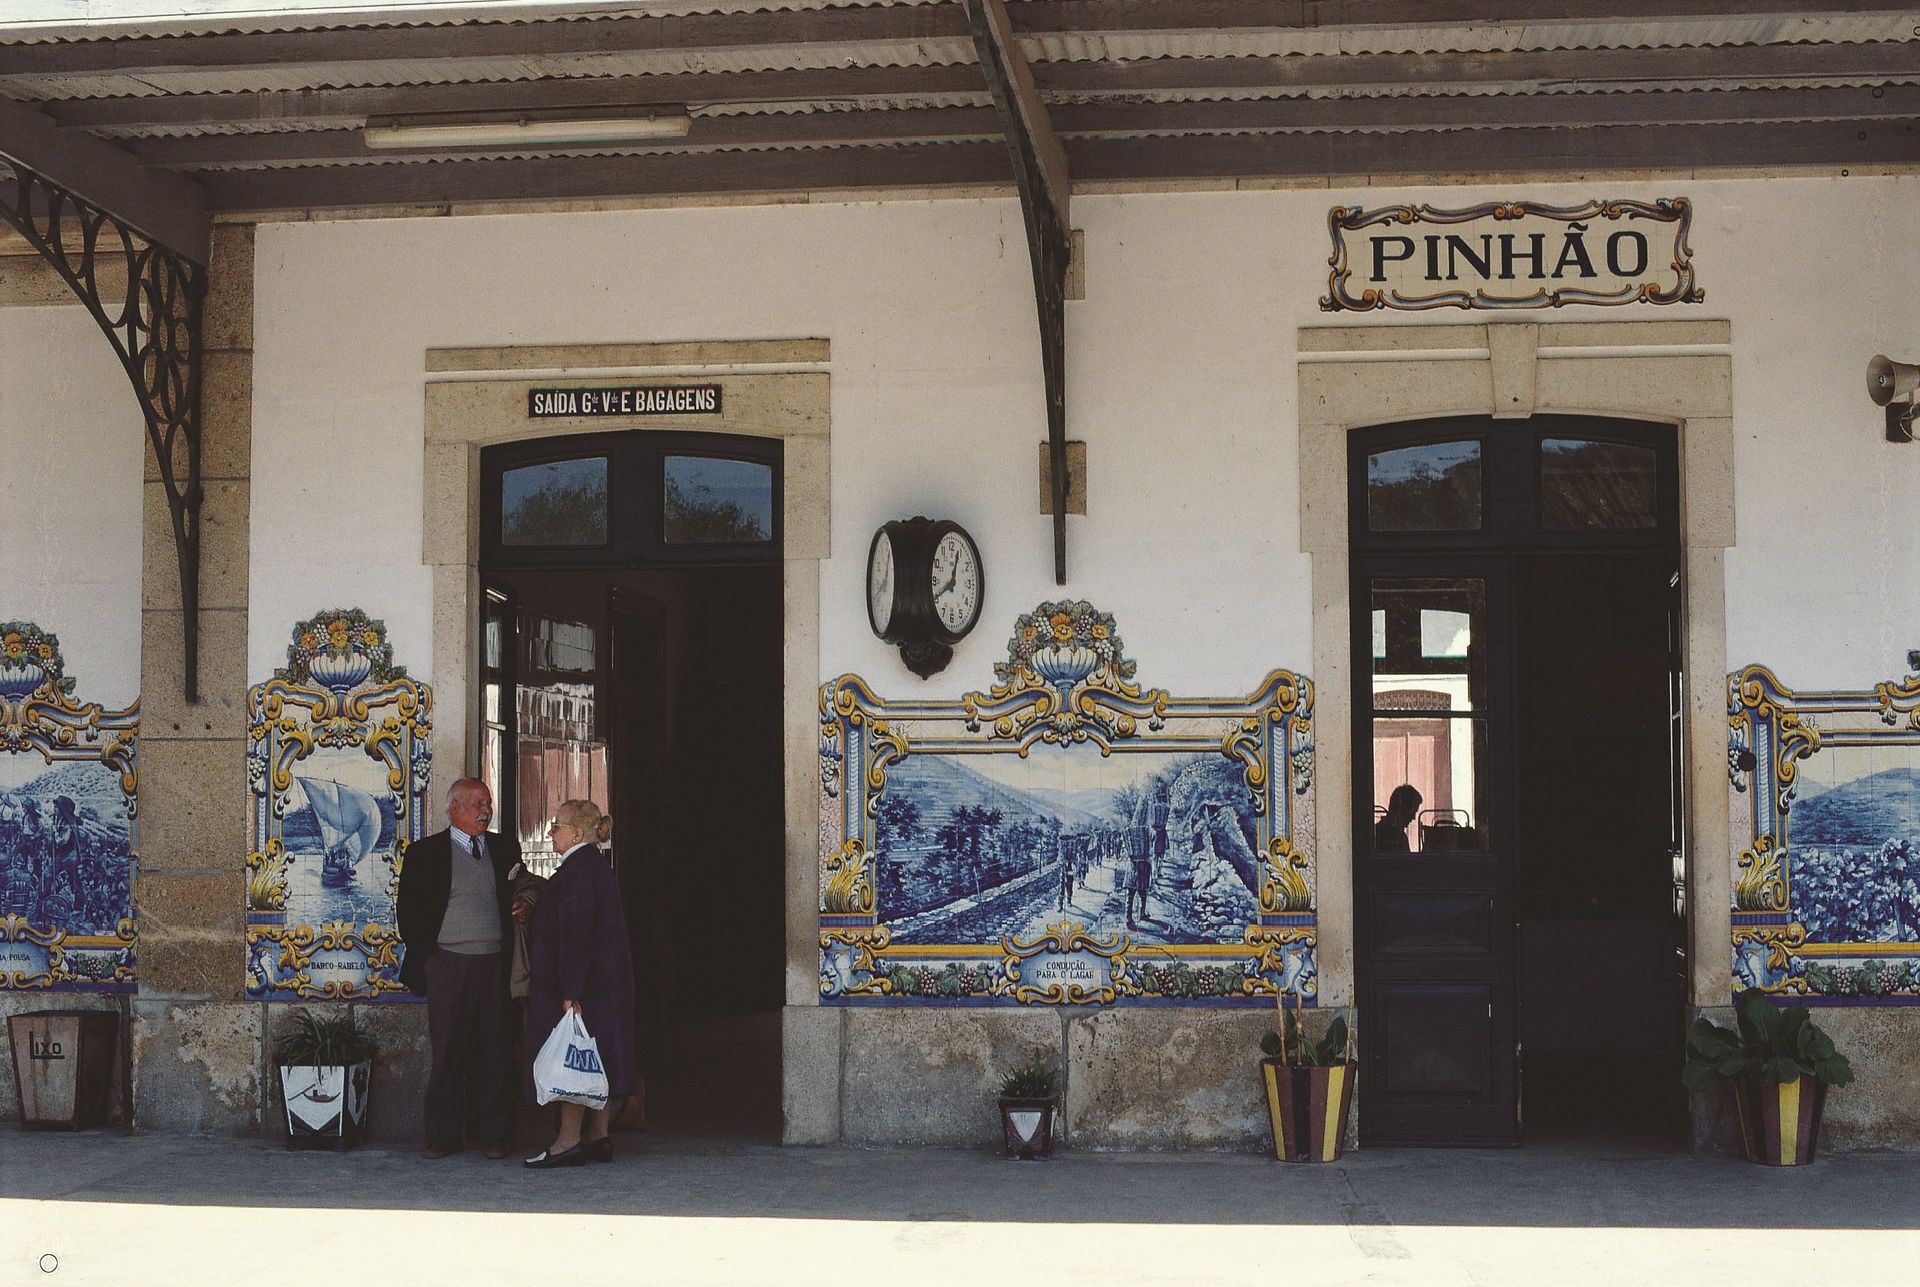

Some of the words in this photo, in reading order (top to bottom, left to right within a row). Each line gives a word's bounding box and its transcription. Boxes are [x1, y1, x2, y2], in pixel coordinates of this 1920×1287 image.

[1369, 222, 1649, 282] PINHÃO
[535, 390, 577, 414] SAÍDA
[621, 391, 631, 412] E
[635, 388, 716, 412] BAGAGENS
[964, 562, 970, 572] 2
[966, 579, 972, 589] 3
[949, 613, 955, 623] 6
[1046, 960, 1086, 972] CONDUÇÃO
[1036, 970, 1057, 979] PARA
[29, 1031, 66, 1060] LIXO
